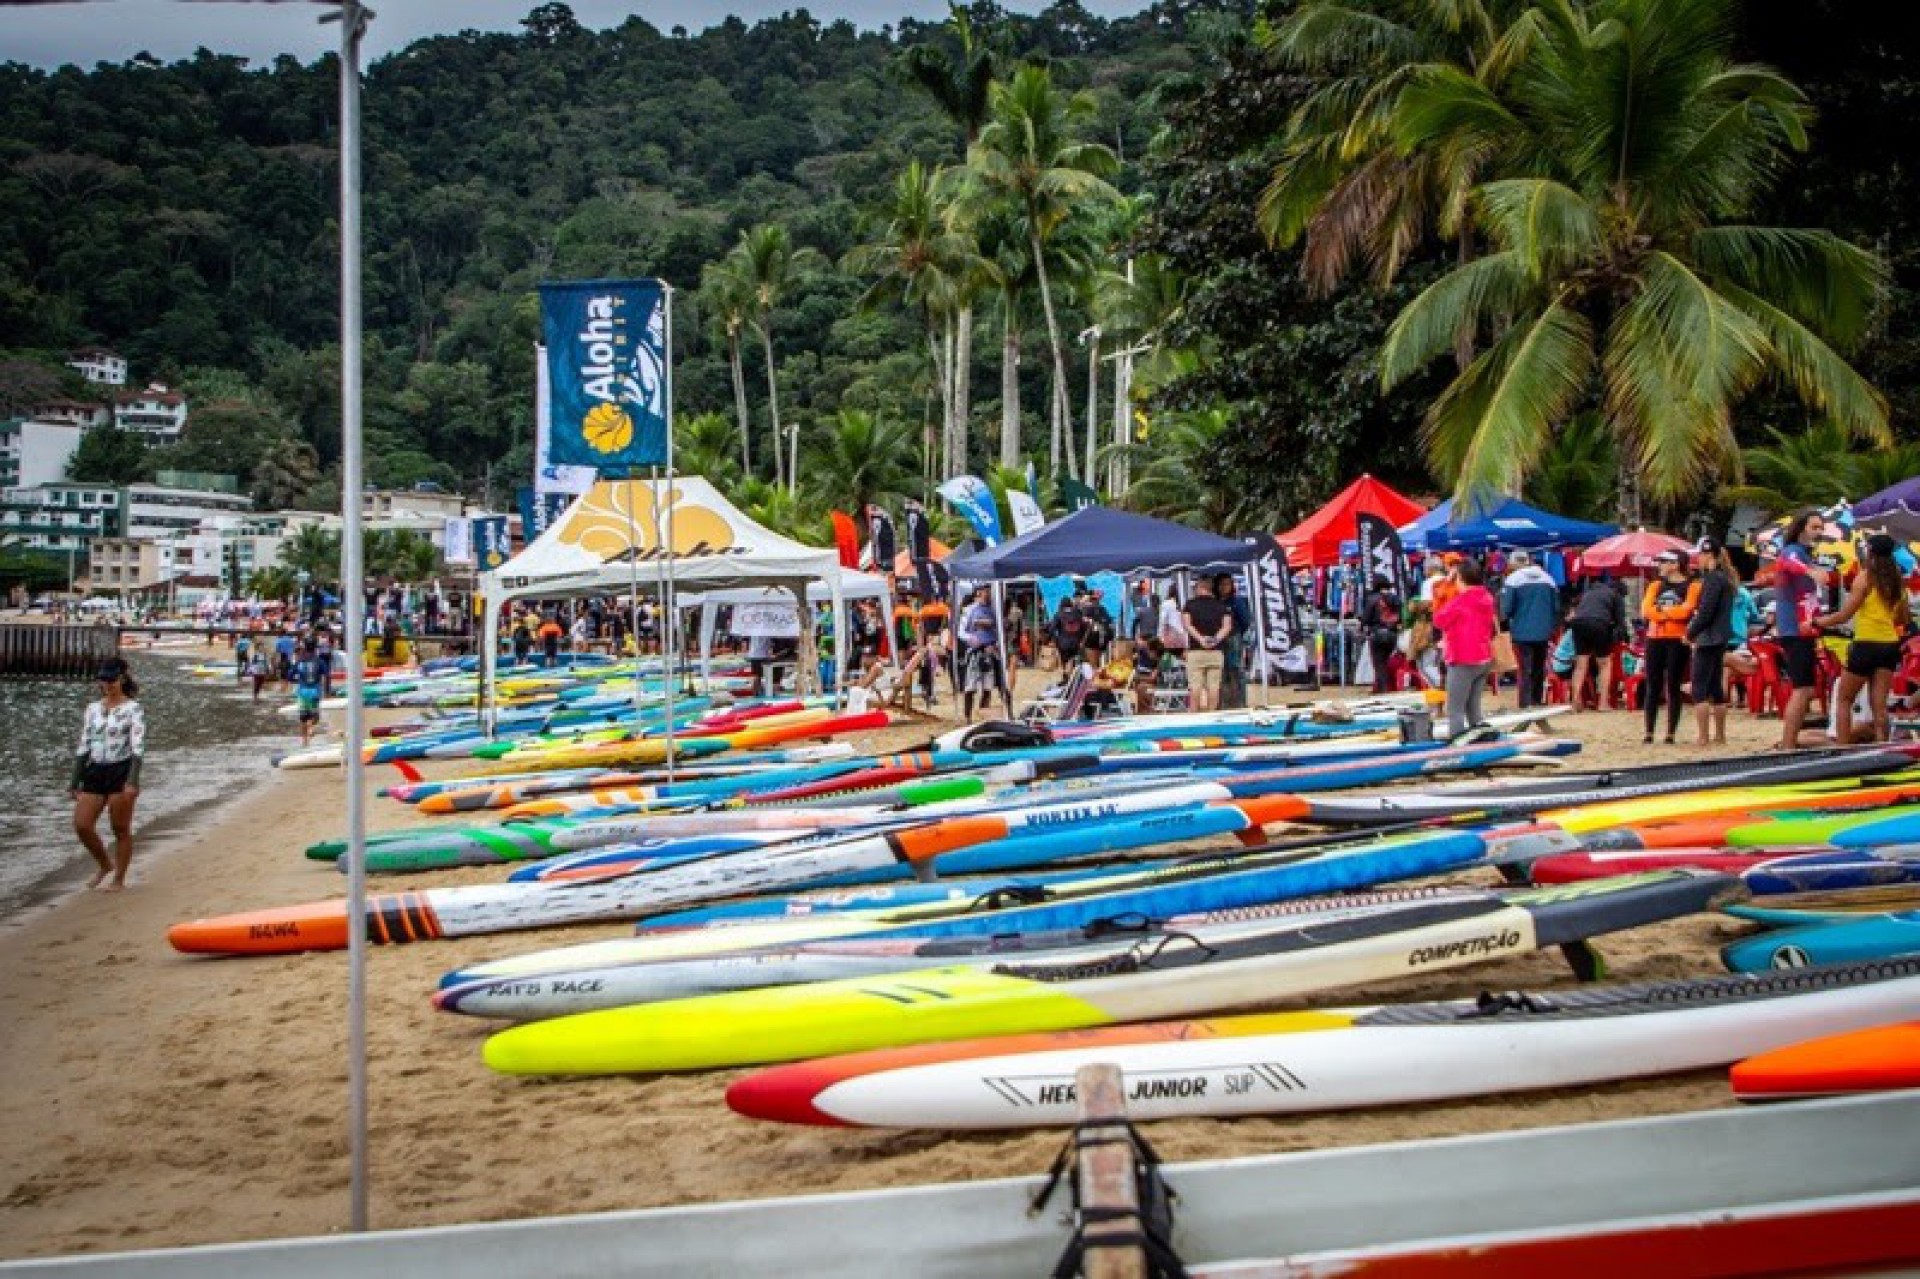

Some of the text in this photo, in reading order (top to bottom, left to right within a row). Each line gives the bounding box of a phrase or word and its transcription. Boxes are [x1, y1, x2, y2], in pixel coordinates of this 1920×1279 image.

[580, 295, 614, 402] Aloha
[1025, 805, 1091, 826] VORTEX
[1408, 928, 1520, 967] COMPETIÇÃO
[552, 978, 605, 995] RACE
[1129, 1075, 1208, 1100] JUNIOR
[1223, 1072, 1256, 1095] SUP
